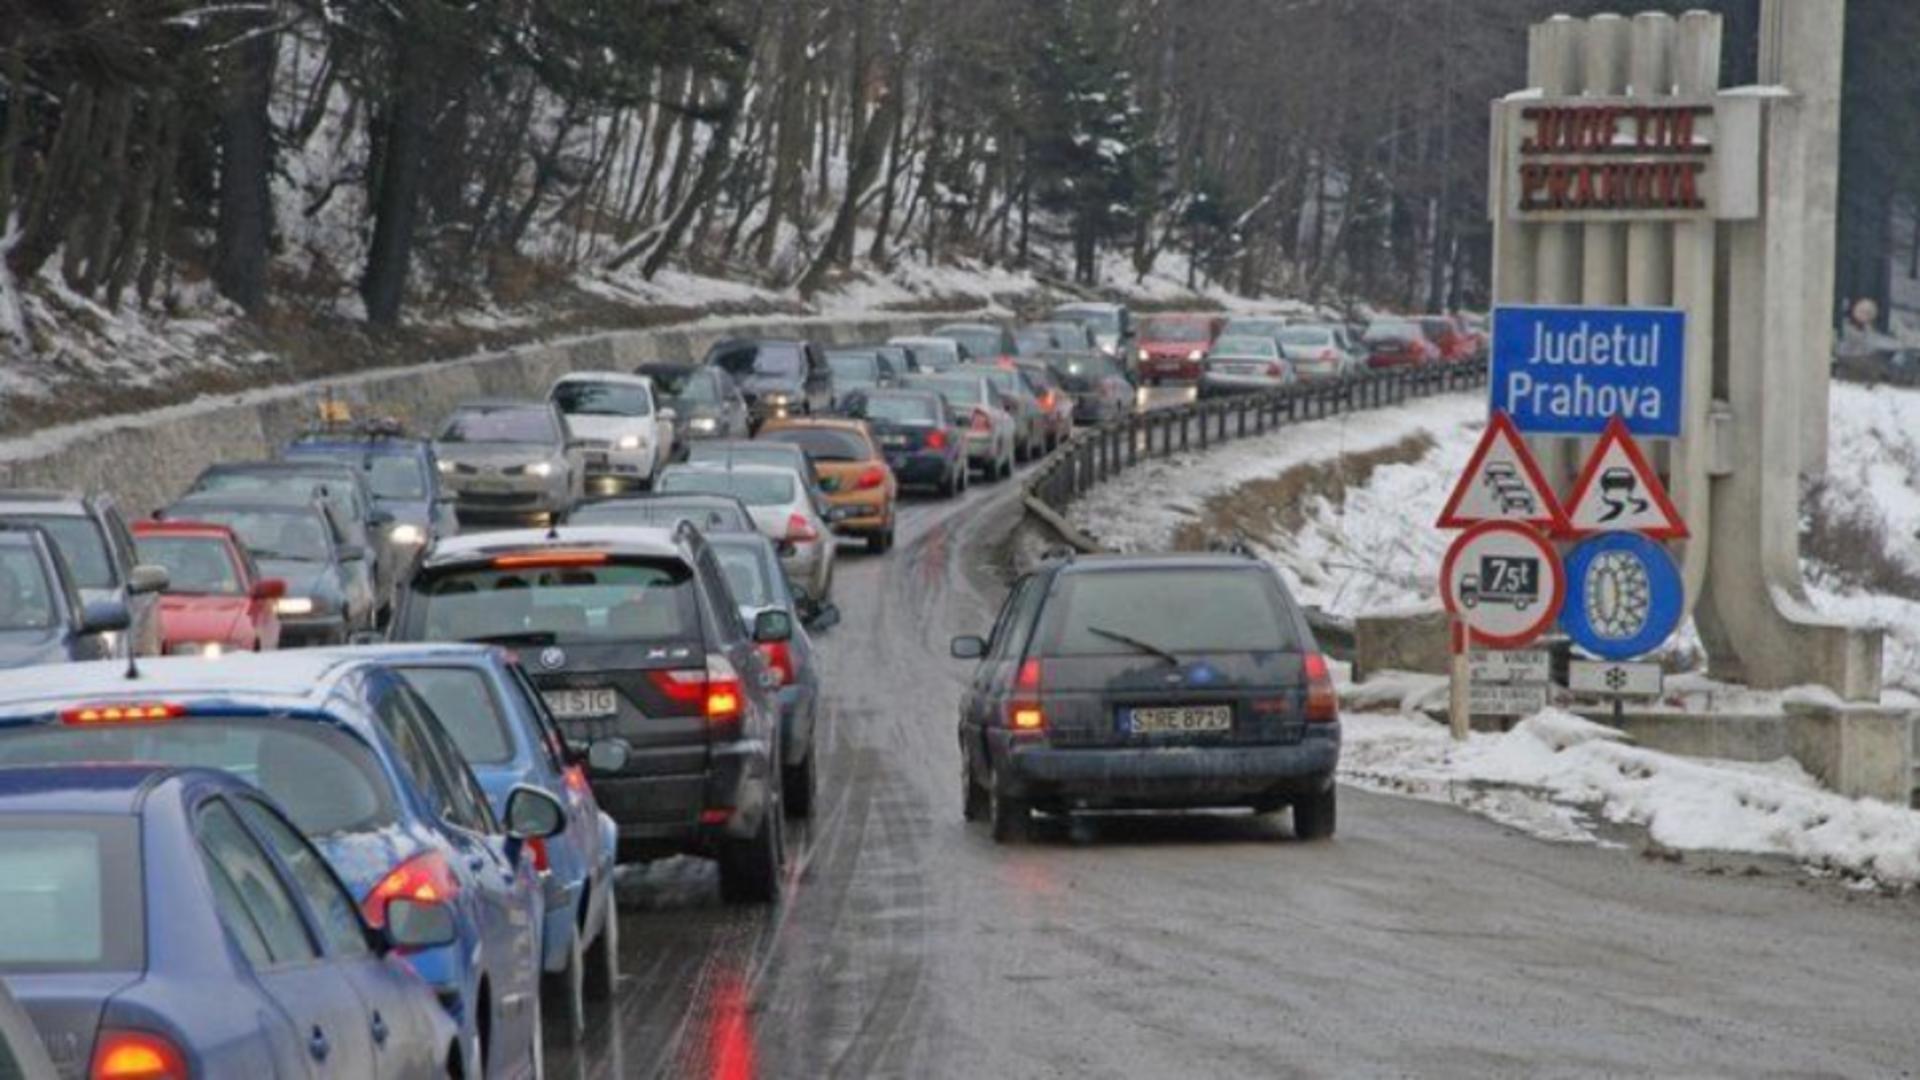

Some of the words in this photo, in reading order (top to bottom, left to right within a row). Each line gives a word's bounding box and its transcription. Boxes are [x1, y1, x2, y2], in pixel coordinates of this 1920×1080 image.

[1529, 320, 1660, 367] Judetul
[1507, 371, 1662, 420] Prahova
[571, 690, 612, 713] SIG
[1182, 706, 1230, 729] 8719
